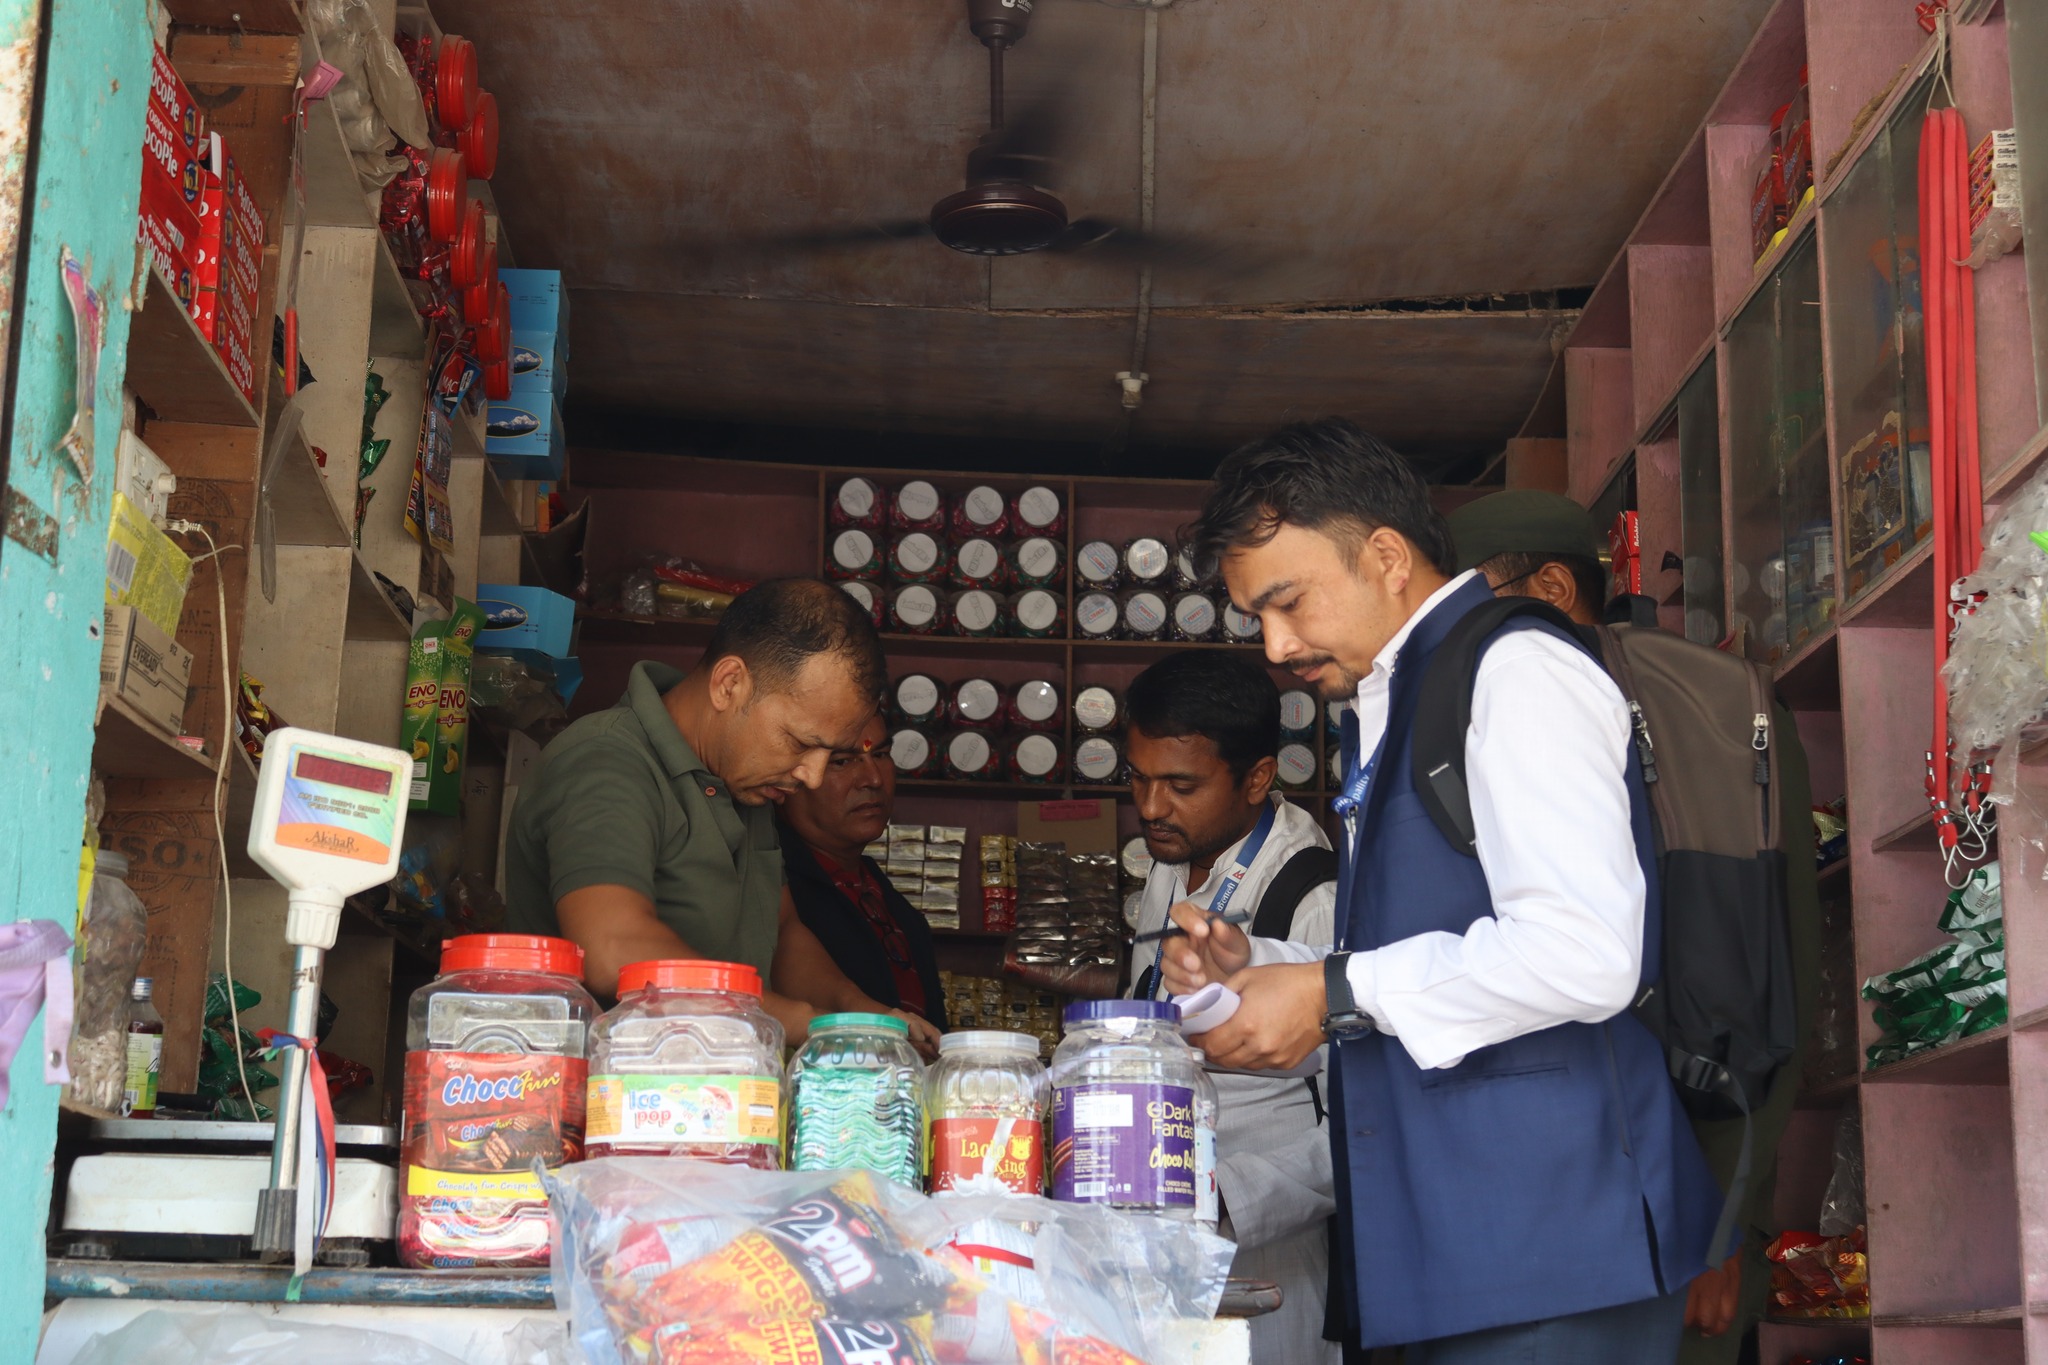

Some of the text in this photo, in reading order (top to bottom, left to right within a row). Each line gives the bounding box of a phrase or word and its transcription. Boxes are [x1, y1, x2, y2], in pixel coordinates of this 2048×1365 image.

[454, 626, 472, 638] ENO
[133, 643, 159, 674] EVEREADY
[409, 683, 437, 699] ENO
[439, 689, 466, 709] ENO
[442, 1073, 524, 1107] Choco
[629, 1089, 662, 1111] Ice
[635, 1110, 672, 1129] pop
[1163, 1102, 1193, 1122] Dark
[1151, 1118, 1194, 1141] Fantas
[961, 1138, 1006, 1159] Lacto
[1149, 1142, 1183, 1169] Choco
[994, 1159, 1027, 1179] King
